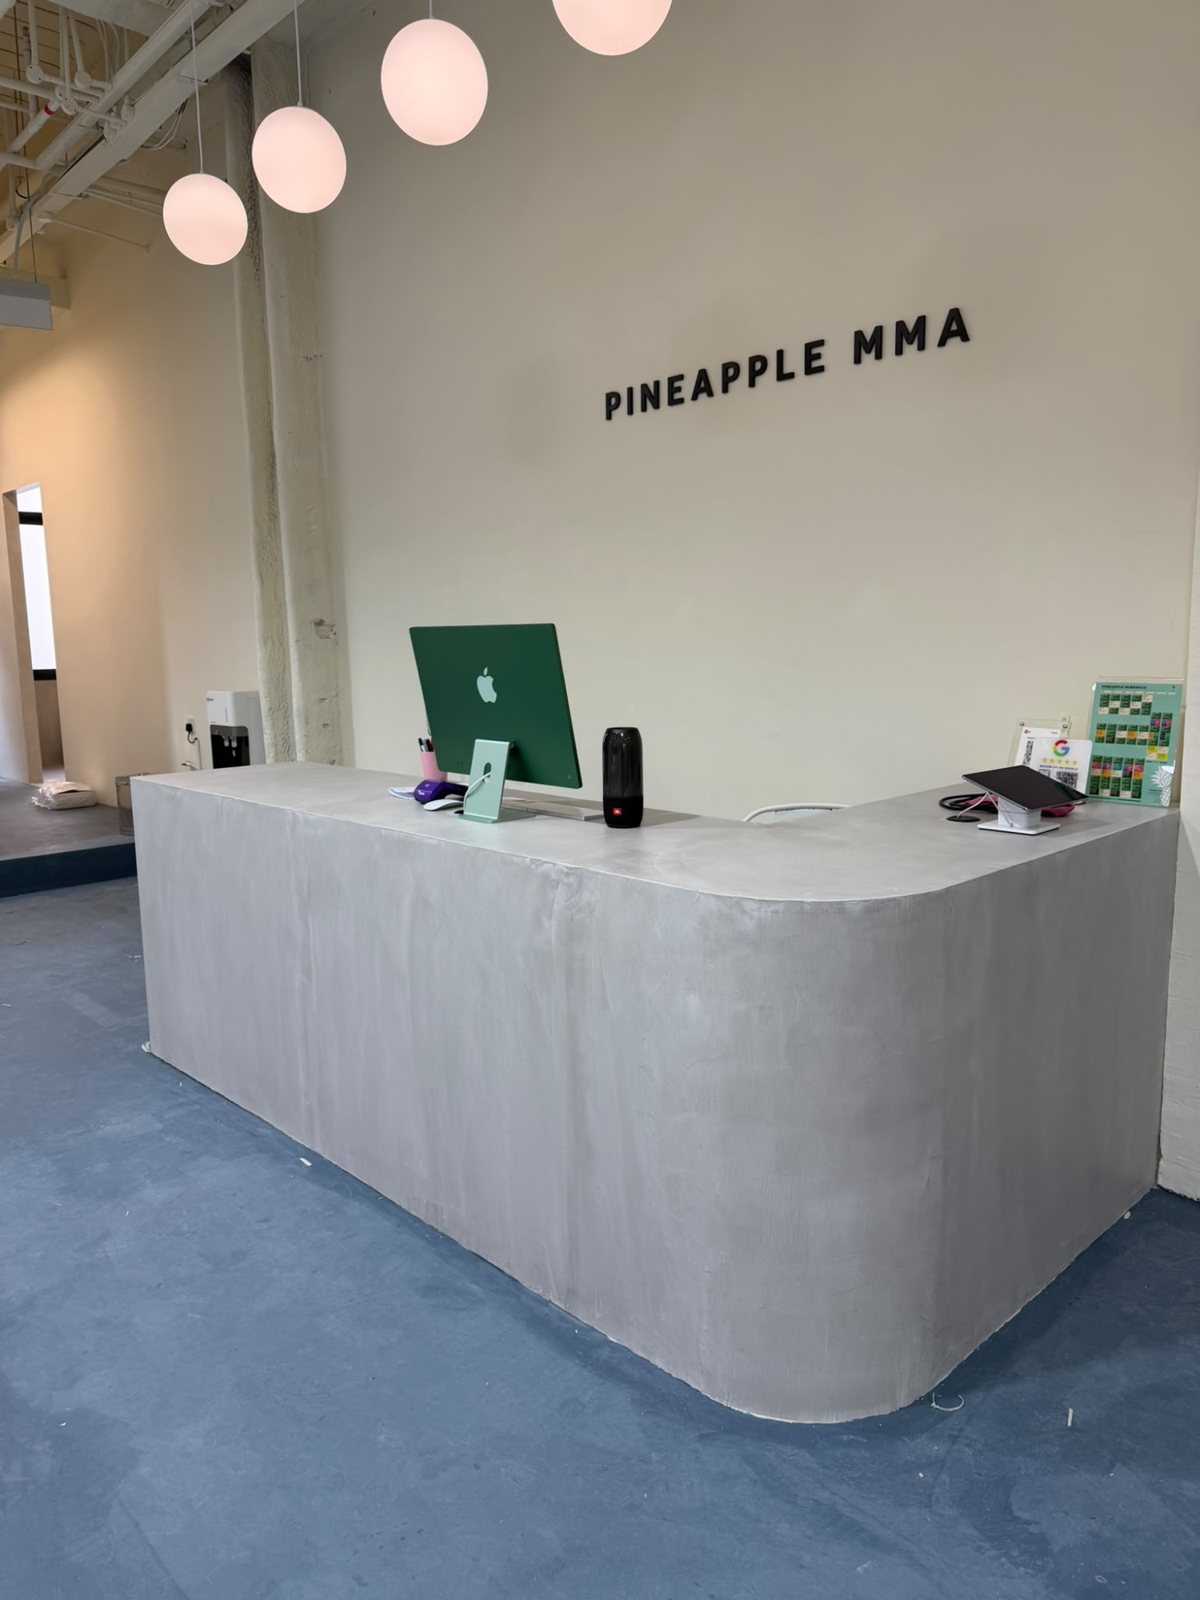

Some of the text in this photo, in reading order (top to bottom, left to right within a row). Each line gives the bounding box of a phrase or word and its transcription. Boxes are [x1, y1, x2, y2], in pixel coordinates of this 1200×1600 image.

[605, 307, 971, 421] PINEAPPLE MMA
[1052, 739, 1070, 757] G
